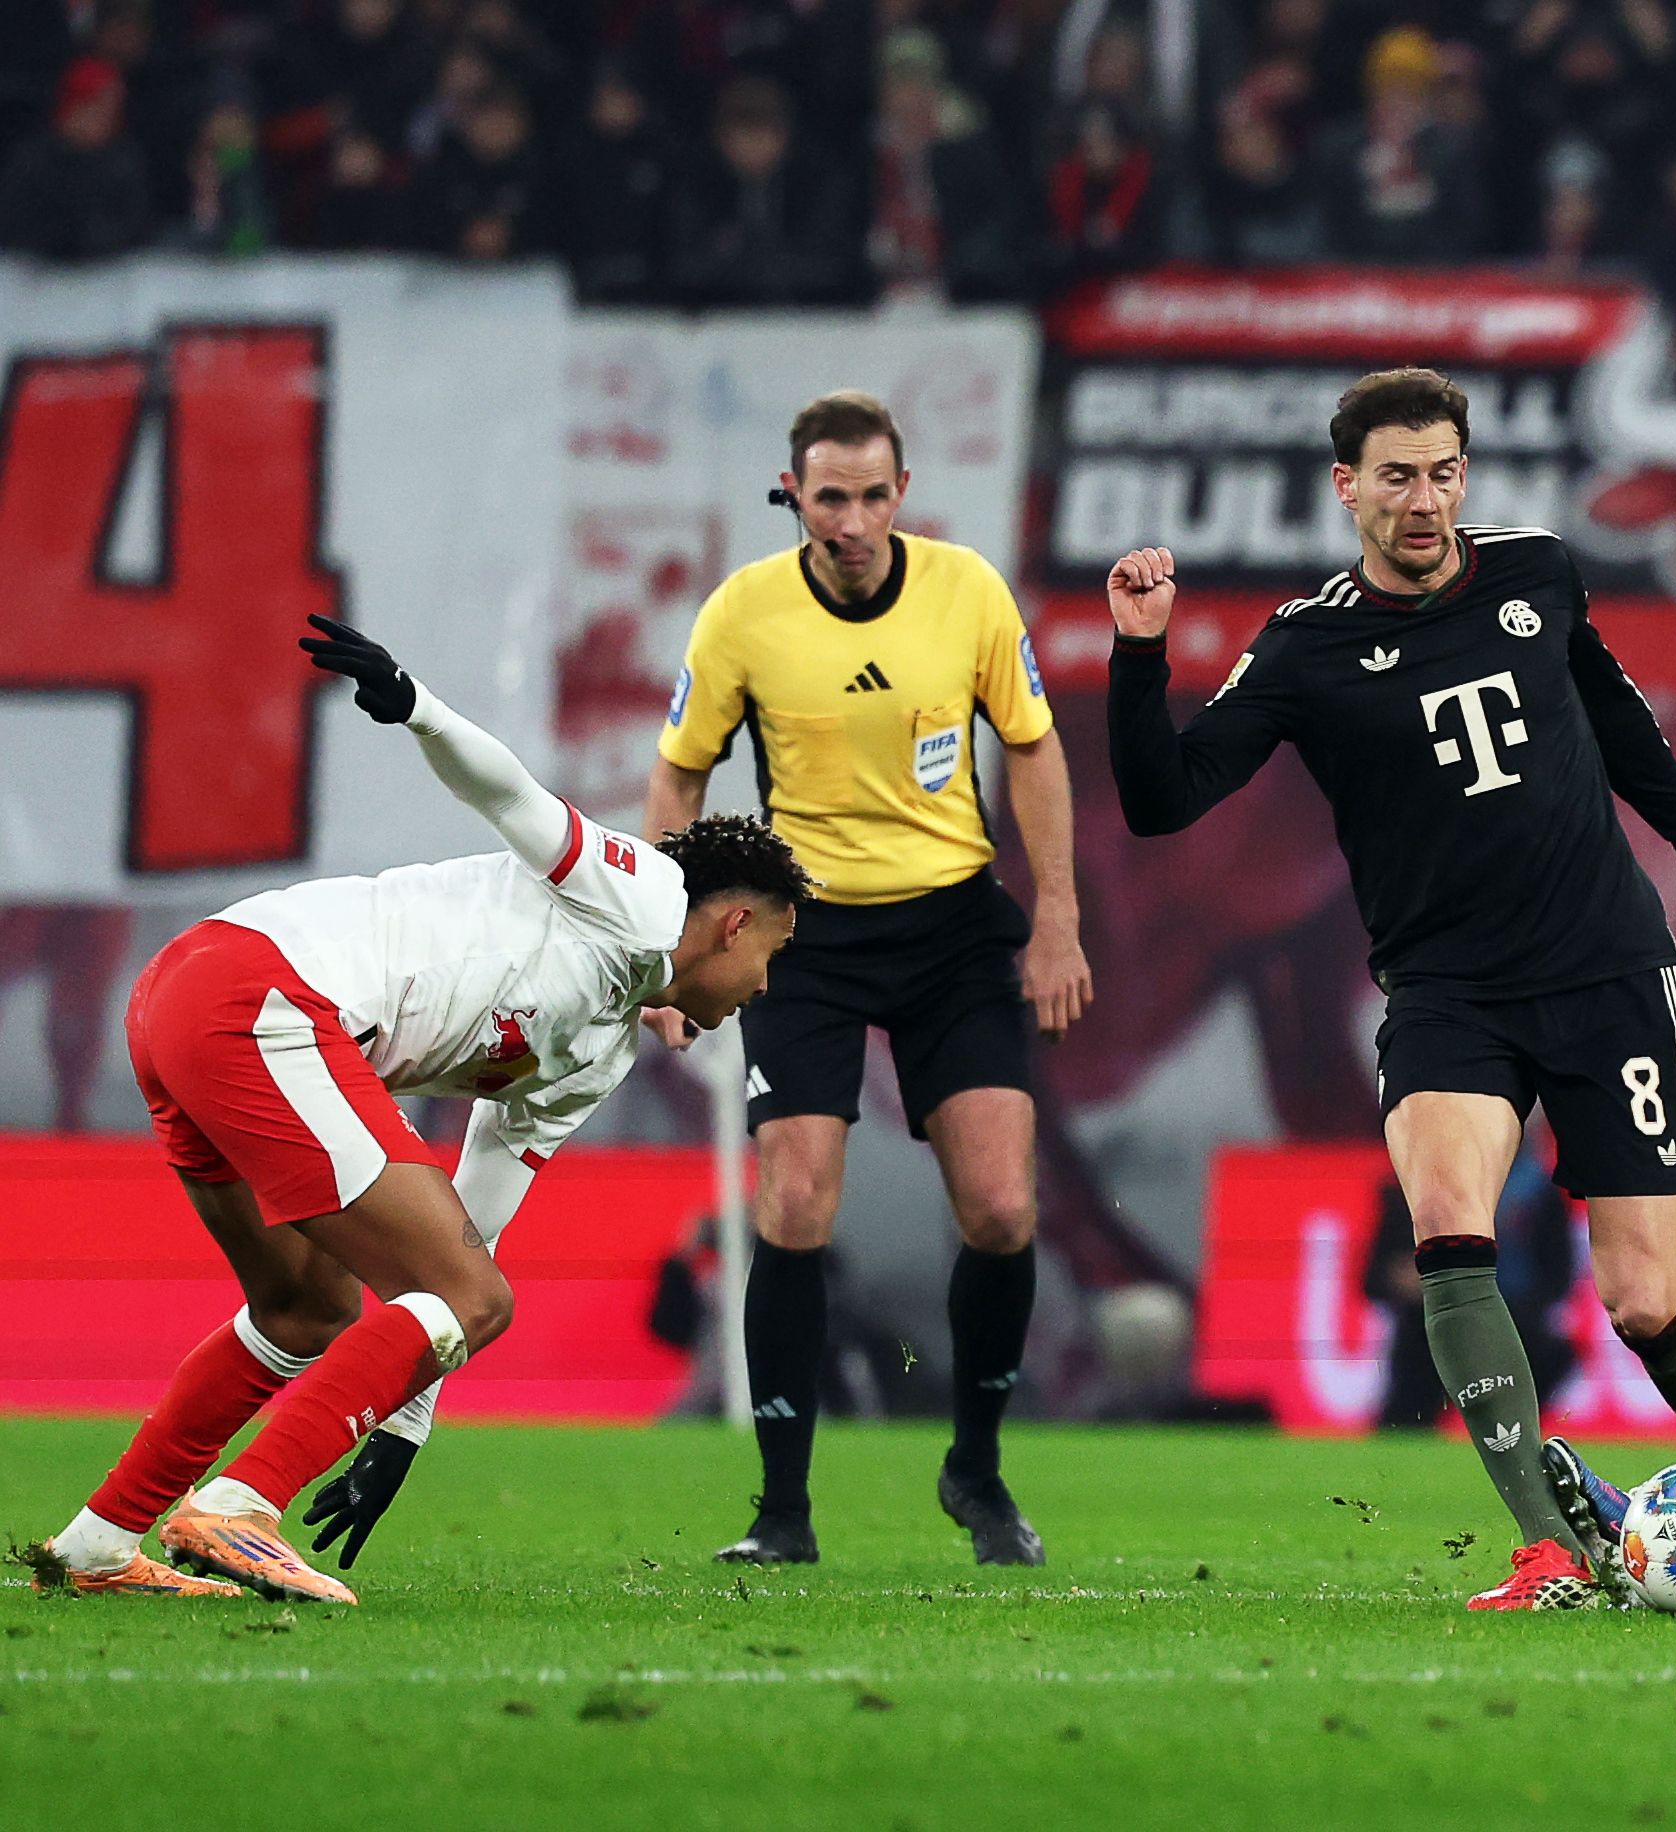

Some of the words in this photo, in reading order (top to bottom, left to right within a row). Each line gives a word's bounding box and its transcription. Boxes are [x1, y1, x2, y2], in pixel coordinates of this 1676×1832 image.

[0, 321, 346, 872] 4
[921, 733, 956, 756] FIFA
[1620, 1056, 1667, 1136] 8
[1457, 1375, 1515, 1408] FCBM
